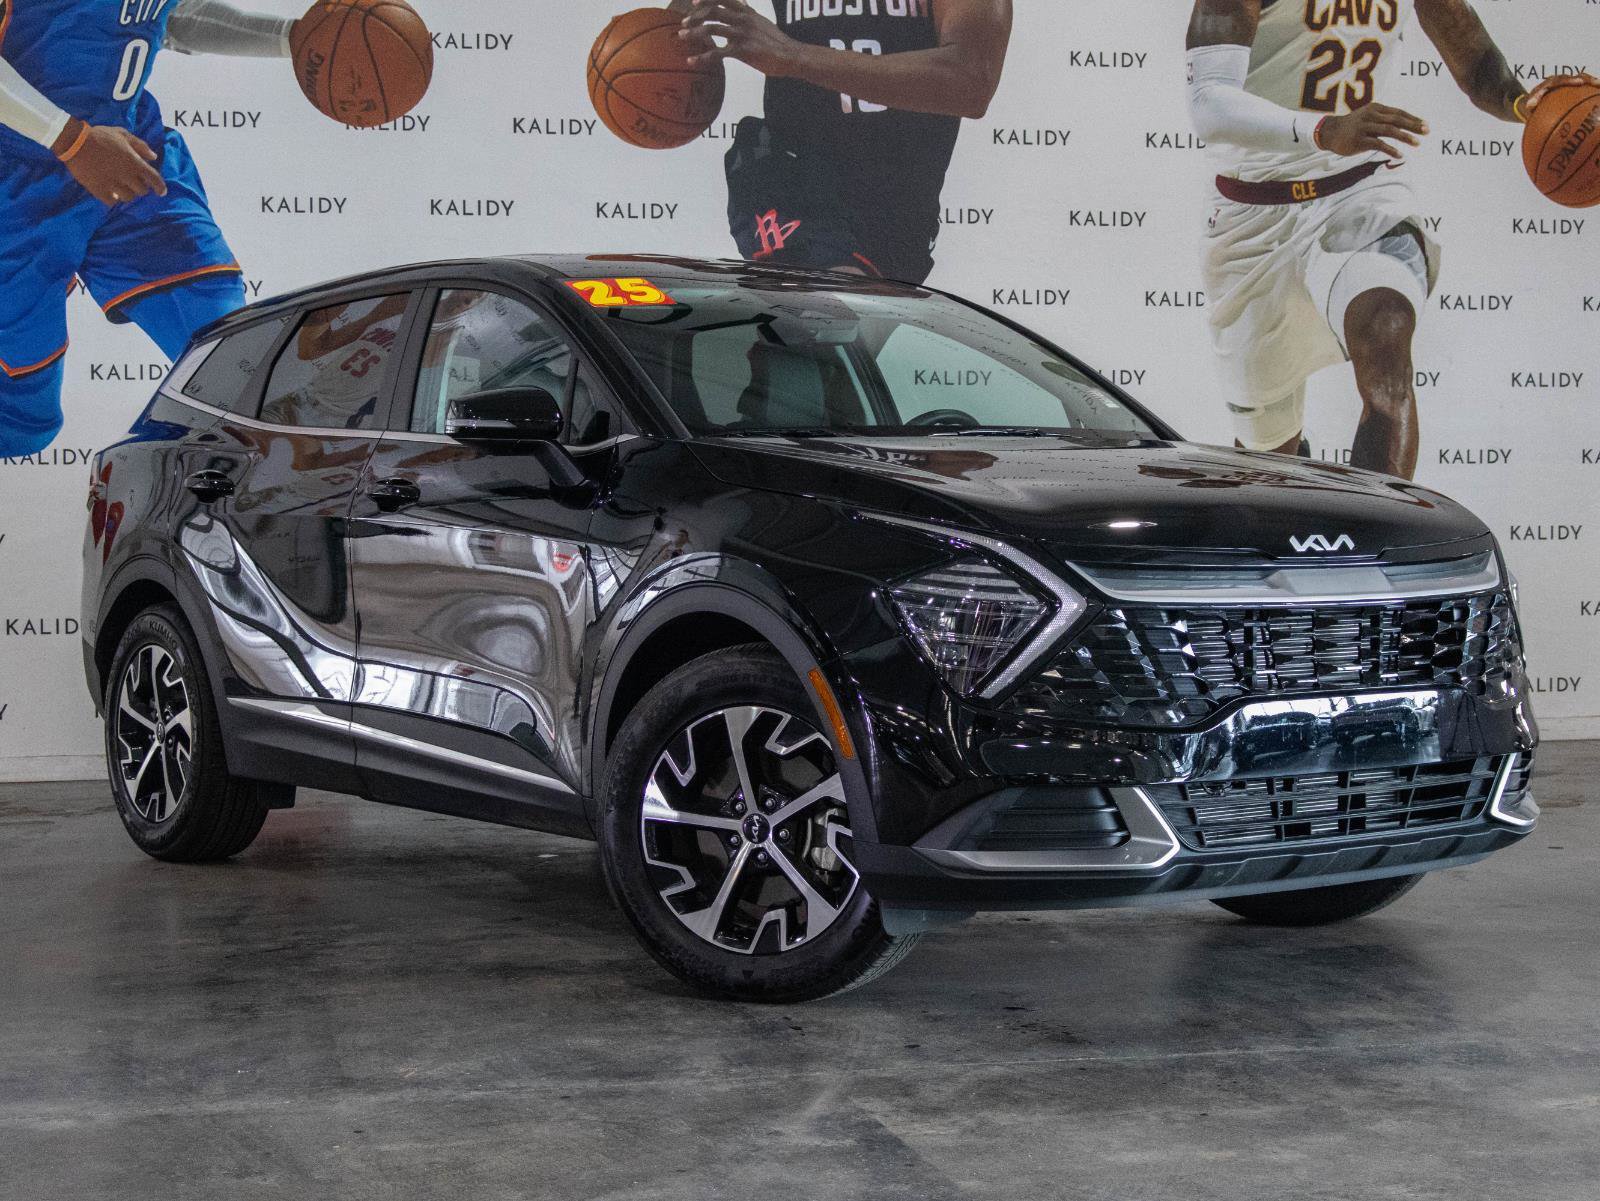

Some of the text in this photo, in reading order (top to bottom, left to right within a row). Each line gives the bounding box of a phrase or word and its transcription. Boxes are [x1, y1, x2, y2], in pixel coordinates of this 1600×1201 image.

[430, 32, 513, 50] KALIDY
[1070, 51, 1147, 68] KALIDY
[112, 38, 149, 101] 0
[1300, 36, 1383, 113] 23
[173, 110, 261, 128] KALIDY
[513, 117, 597, 136] KALIDY
[993, 129, 1070, 146] KALIDY
[1441, 140, 1515, 156] KALIDY
[1292, 181, 1317, 200] CLE
[261, 197, 346, 214] KALIDY
[430, 199, 514, 217] KALIDY
[596, 203, 678, 220] KALIDY
[1070, 211, 1147, 227] KALIDY
[1512, 219, 1585, 235] KALIDY
[572, 278, 666, 305] 25
[993, 289, 1070, 306] KALIDY
[1145, 291, 1204, 307] KALID
[1440, 295, 1513, 310] KALIDY
[914, 370, 992, 386] KALIDY
[1511, 372, 1584, 388] KALIDY
[1439, 449, 1512, 465] KALIDY
[1510, 525, 1583, 541] KALIDY
[6, 618, 79, 635] KALID
